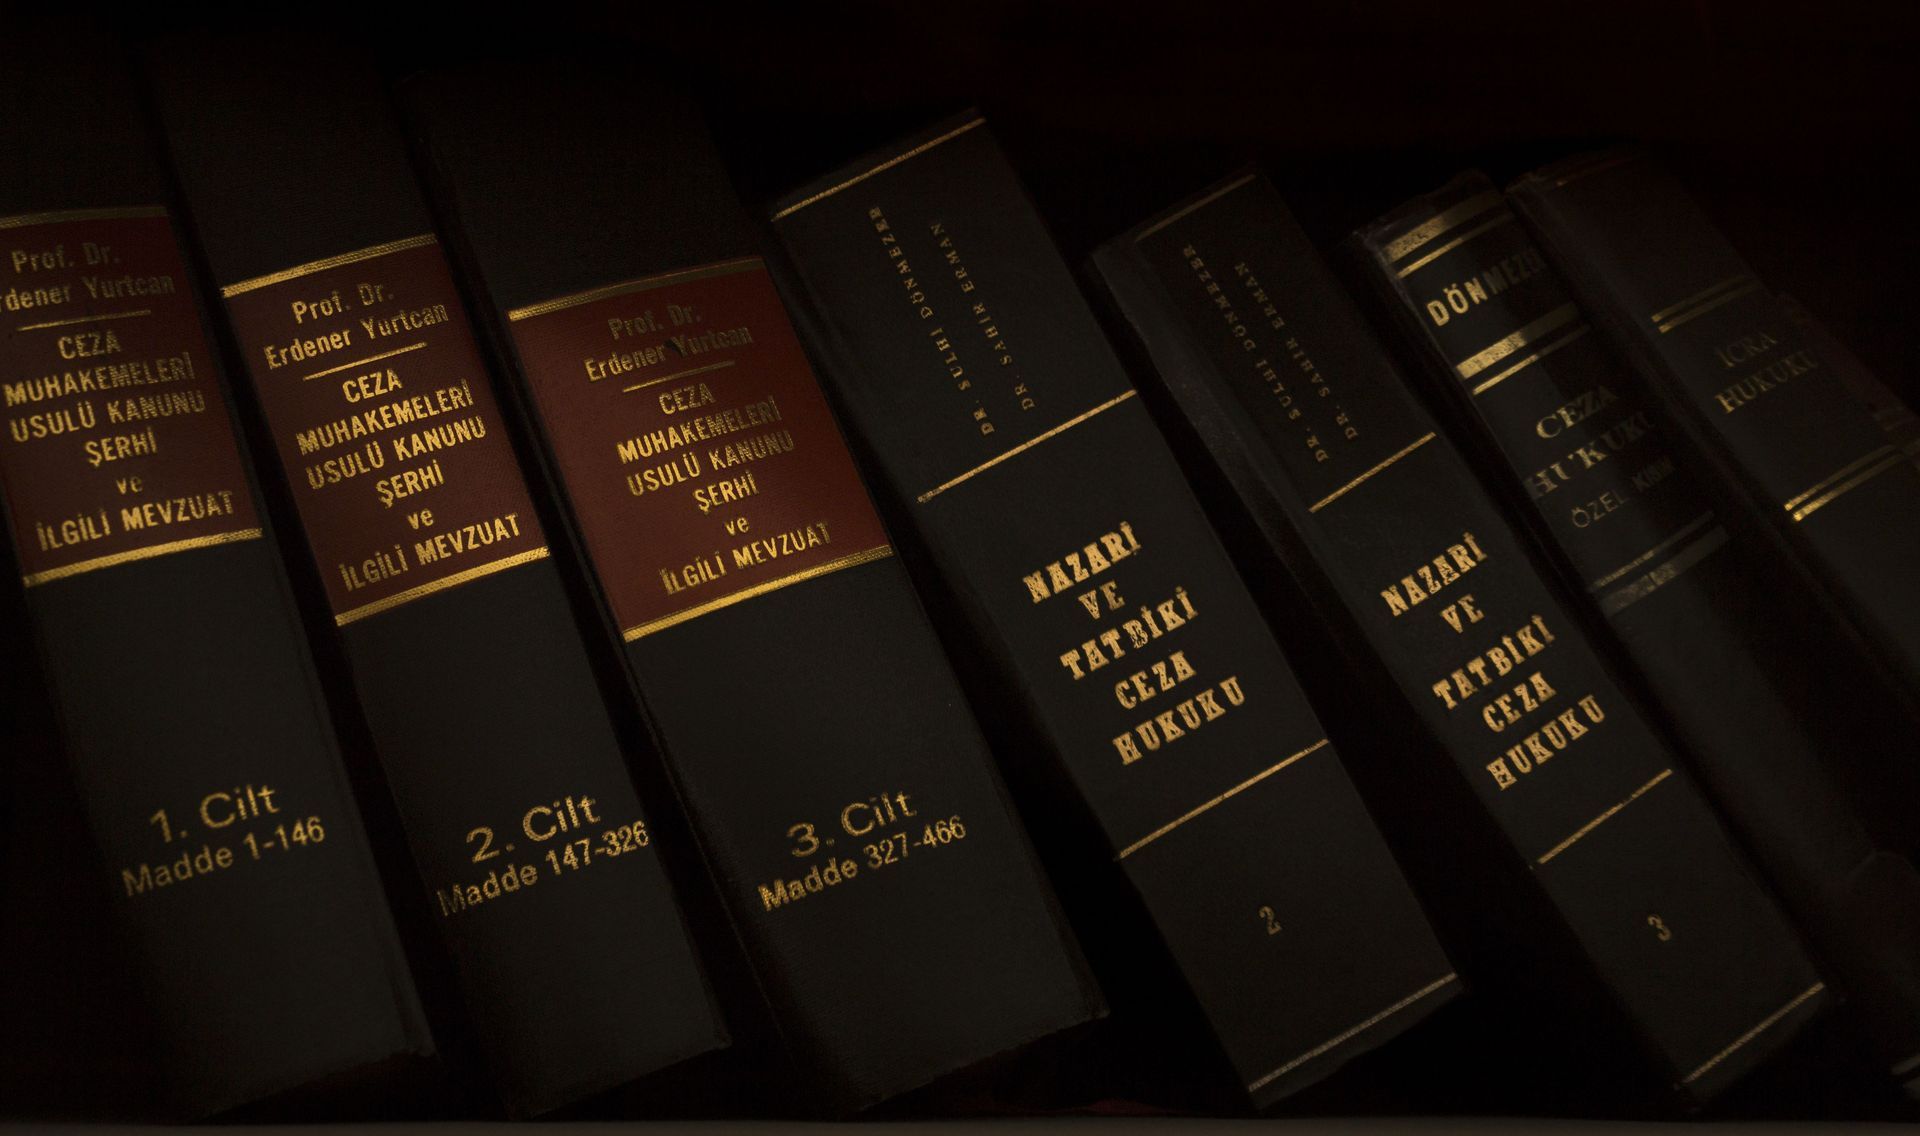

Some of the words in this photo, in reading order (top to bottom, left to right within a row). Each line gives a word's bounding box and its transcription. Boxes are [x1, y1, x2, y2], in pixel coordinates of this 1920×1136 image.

[11, 248, 73, 274] Prof.
[84, 242, 121, 264] Dr.
[930, 222, 976, 294] ERMAN
[0, 284, 70, 313] dener
[82, 273, 175, 300] Yurtcan
[290, 290, 351, 325] Prof.
[357, 282, 395, 307] Dr.
[57, 329, 121, 360] CEZA
[263, 326, 352, 371] Erdener
[359, 302, 449, 342] Yurtcan
[607, 310, 664, 341] Prof.
[667, 302, 700, 327] Dr.
[2, 351, 196, 407] MUHAKEMELERİ
[583, 342, 667, 383] Erdener
[671, 326, 753, 359] Yurtcan
[342, 368, 403, 404] CEZA
[658, 382, 716, 416] CEZA
[1013, 374, 1036, 411] DR.
[1536, 384, 1620, 440] CEZA
[9, 400, 96, 443] USULÜ
[107, 390, 207, 425] KANUNU
[295, 378, 474, 457] MUHAKEMELERİ
[615, 395, 783, 464] MUHAKEMELERİ
[971, 400, 996, 437] DR.
[1336, 405, 1359, 440] DR.
[84, 426, 158, 467] ŞERHİ
[306, 441, 386, 491] USULÜ
[393, 415, 488, 463] KANUNU
[626, 453, 701, 496] USULÜ
[710, 430, 794, 471] KANUNU
[1305, 427, 1330, 463] DR.
[116, 474, 144, 496] ve
[374, 459, 444, 510] ŞERHİ
[693, 469, 759, 515] ŞERHİ
[1570, 487, 1629, 529] ÖZEL
[36, 507, 111, 552] İLGİLİ
[120, 490, 234, 533] MEVZUAT
[407, 507, 434, 530] ve
[724, 516, 750, 536] ve
[338, 543, 407, 592] İLGİLİ
[415, 511, 521, 566] MEVZUAT
[659, 550, 728, 596] İLGİLİ
[733, 521, 832, 571] MEVZUAT
[1022, 520, 1143, 605] NAZARİ
[1380, 529, 1489, 617] NAZARİ
[1078, 579, 1126, 621] VE
[1439, 593, 1486, 634] VE
[1058, 584, 1200, 682] TATBİKİ
[1114, 649, 1198, 711] CEZA
[1432, 612, 1557, 712] TATBİKİ
[1112, 675, 1246, 767] HUKUKU
[1481, 670, 1558, 734] CEZA
[1486, 694, 1606, 791] HUKUKU
[150, 808, 189, 844] 1.
[200, 783, 281, 829] Cilt
[465, 825, 515, 864] 2.
[521, 794, 601, 844] Cilt
[785, 821, 836, 858] 3.
[839, 789, 918, 837] Cilt
[120, 845, 234, 898] Madde
[242, 815, 326, 860] 1-146
[436, 863, 539, 917] Madde
[545, 819, 650, 877] 147-326
[758, 855, 859, 913] Madde
[863, 814, 967, 870] 327-466
[1257, 904, 1283, 937] 2
[1647, 912, 1673, 942] 3
